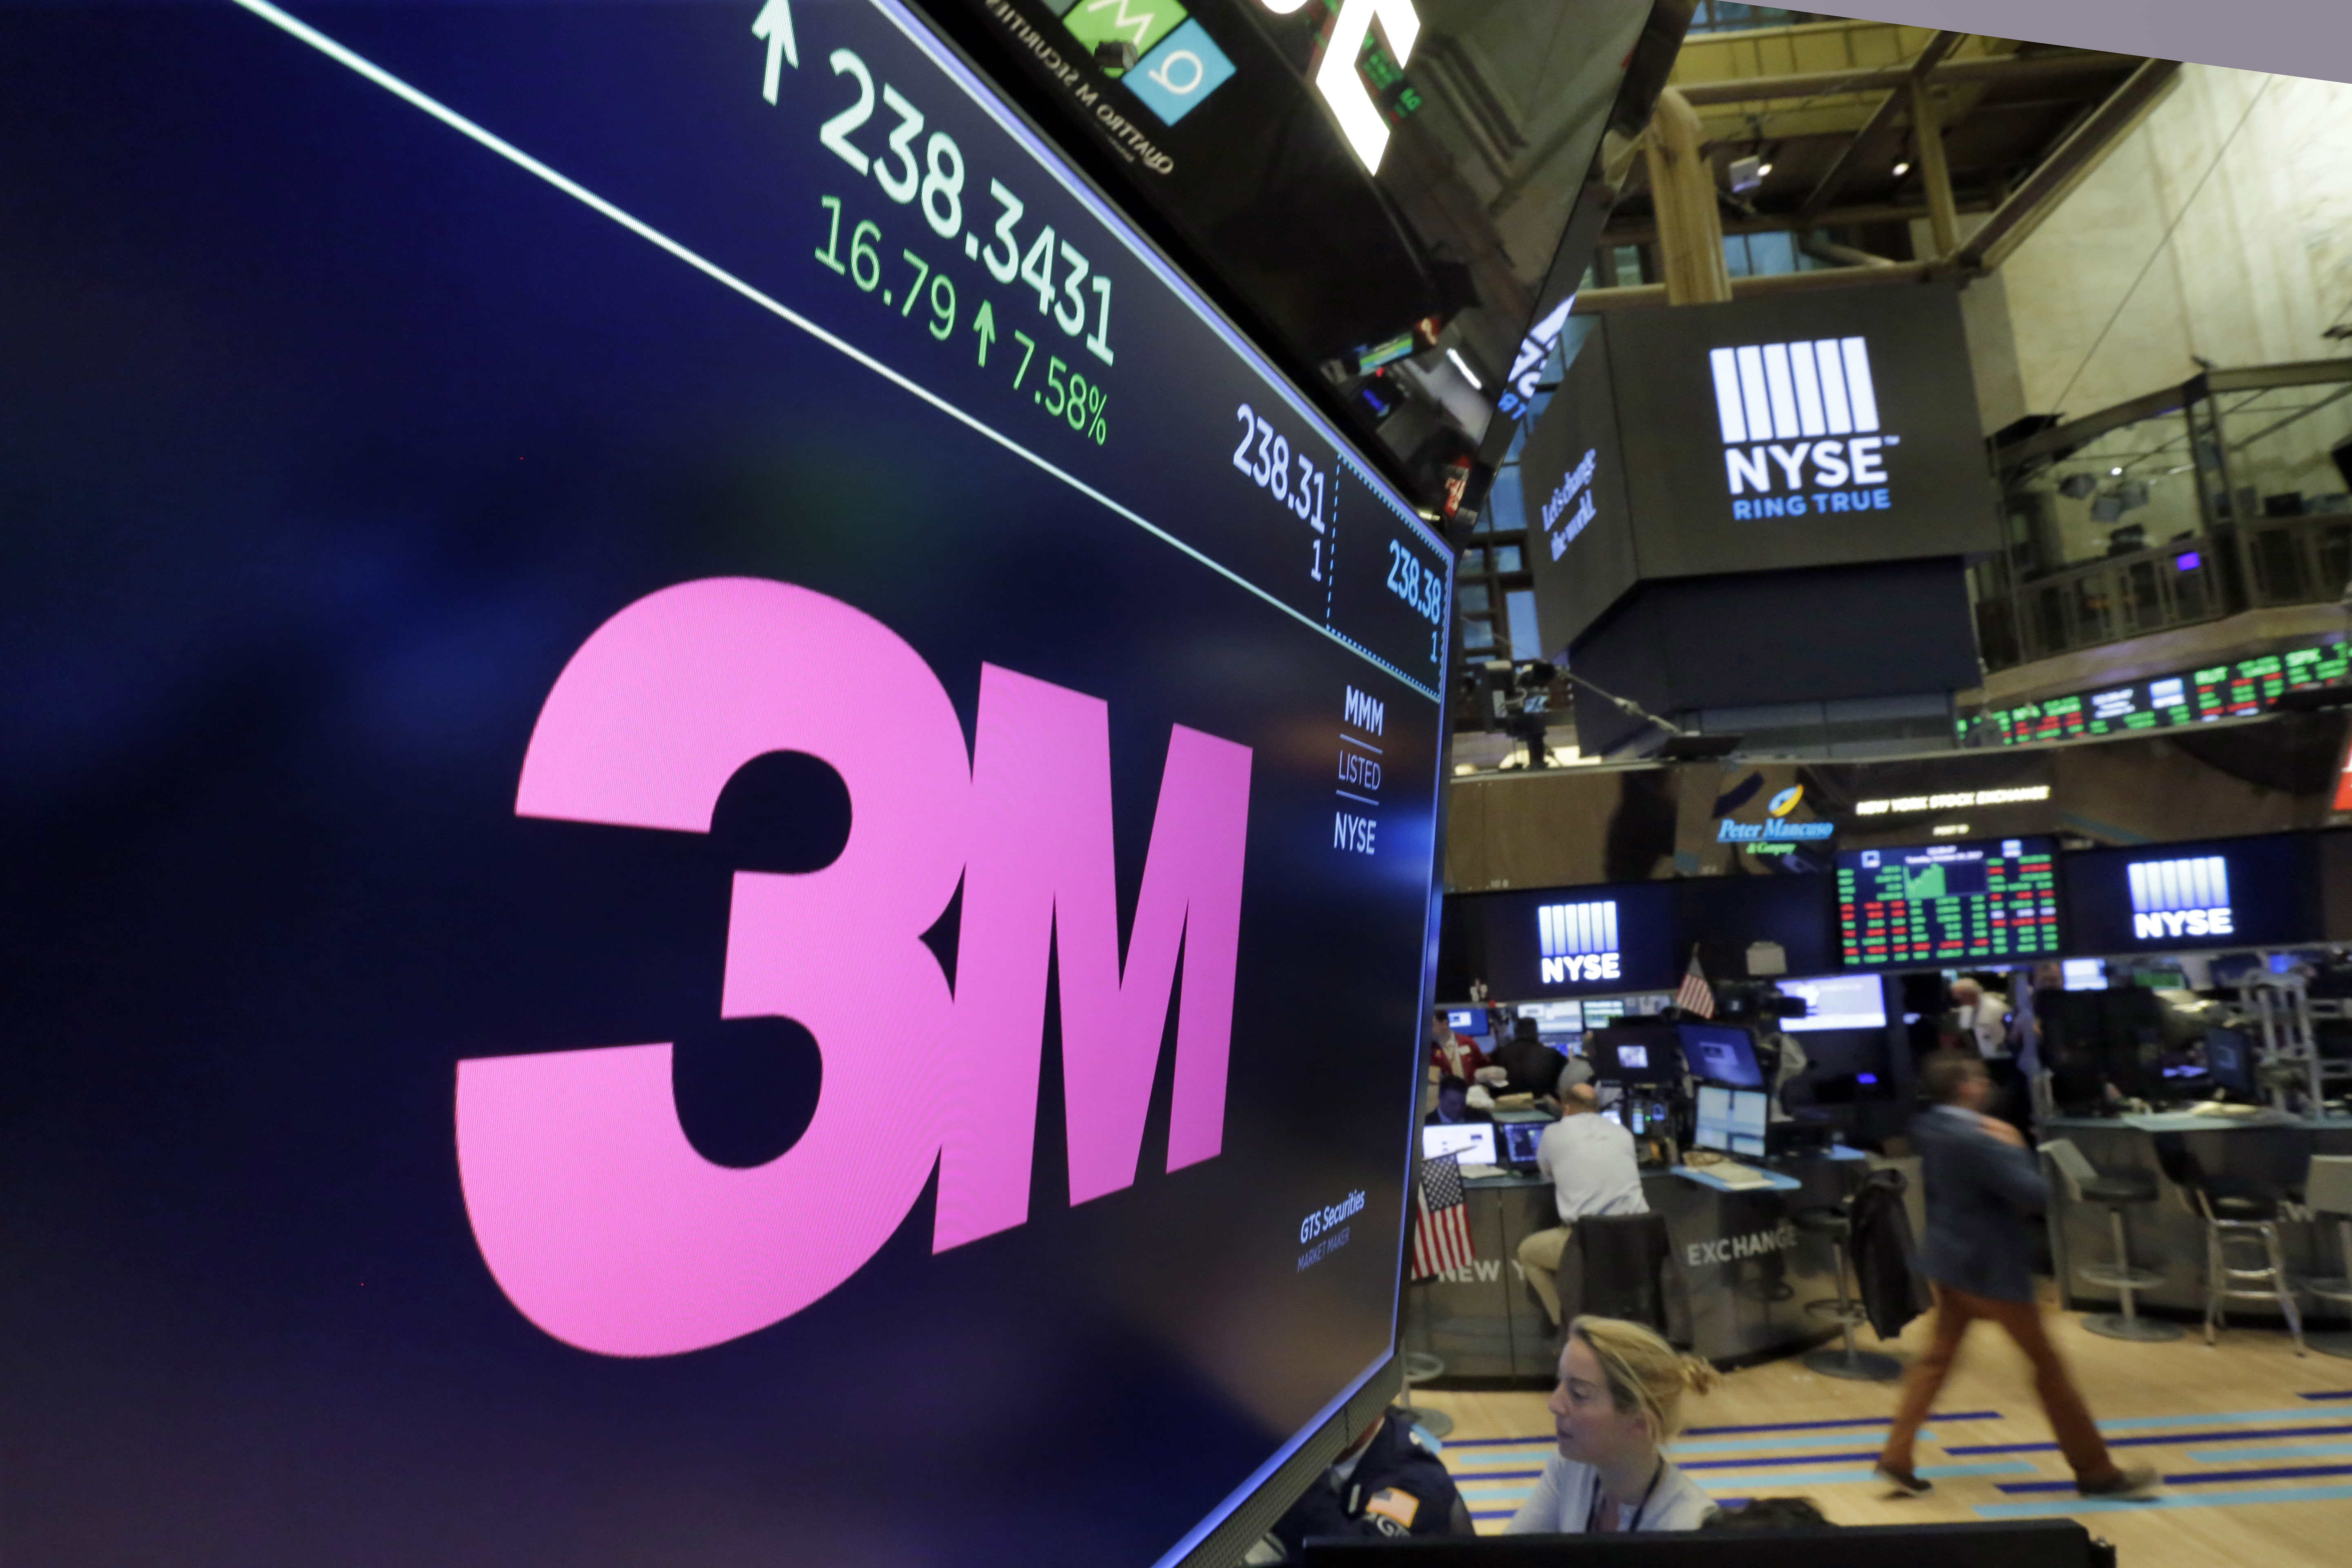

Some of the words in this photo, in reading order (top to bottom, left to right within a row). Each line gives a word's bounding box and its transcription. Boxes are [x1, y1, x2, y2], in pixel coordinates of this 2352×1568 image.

[820, 48, 1114, 366] 238.3431
[815, 195, 957, 340] 16.79
[1013, 330, 1107, 445] 7.58%
[1233, 404, 1325, 534] 238.31
[1733, 494, 1807, 521] RING
[1811, 488, 1892, 513] TRUE
[1311, 539, 1322, 581] 1
[1387, 539, 1441, 624] 238.38
[1430, 631, 1437, 663] 1
[1344, 684, 1384, 737] MMM
[1338, 750, 1381, 791] LISTED
[1856, 800, 1890, 815] NEW
[1891, 796, 1929, 813] YORK
[1929, 792, 1976, 809] STOCK
[1975, 786, 2050, 805] EXCHANGE
[1334, 811, 1377, 855] NYSE
[1717, 818, 1763, 837] Peter
[1762, 817, 1834, 837] Mancuso
[2134, 906, 2234, 939] NYSE
[454, 577, 1253, 1358] 3M
[1541, 952, 1621, 984] NYSE
[1300, 1210, 1321, 1244] GTS
[1322, 1189, 1365, 1232] Securities
